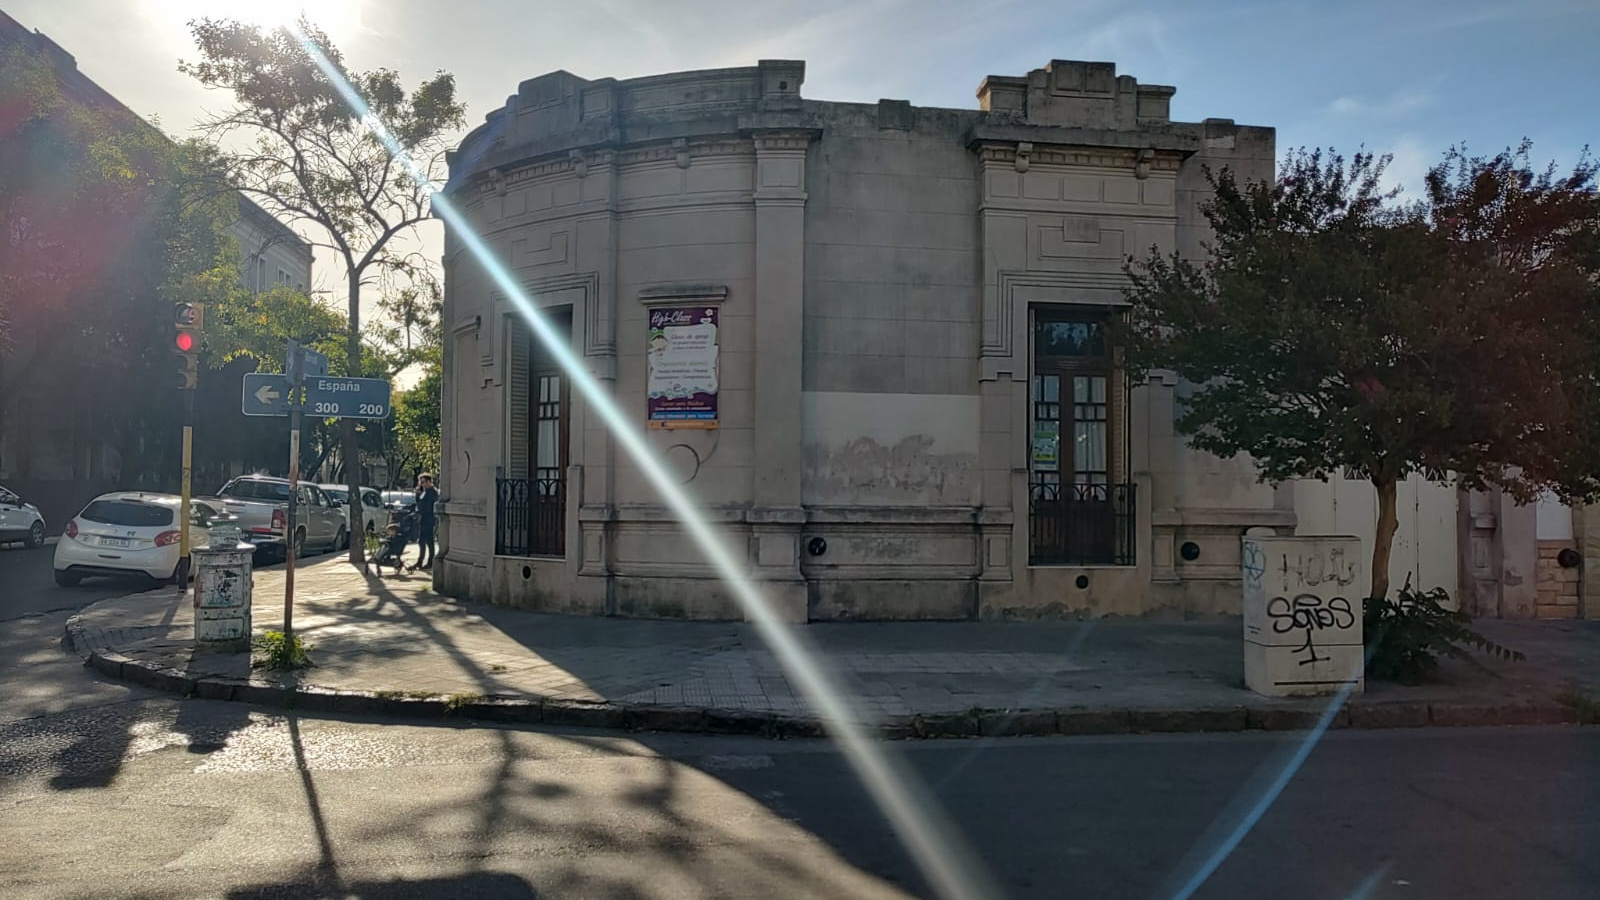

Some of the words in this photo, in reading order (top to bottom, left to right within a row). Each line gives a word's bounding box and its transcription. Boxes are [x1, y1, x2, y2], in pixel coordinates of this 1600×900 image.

[318, 380, 360, 393] España
[315, 402, 339, 413] 300
[359, 404, 383, 415] 200
